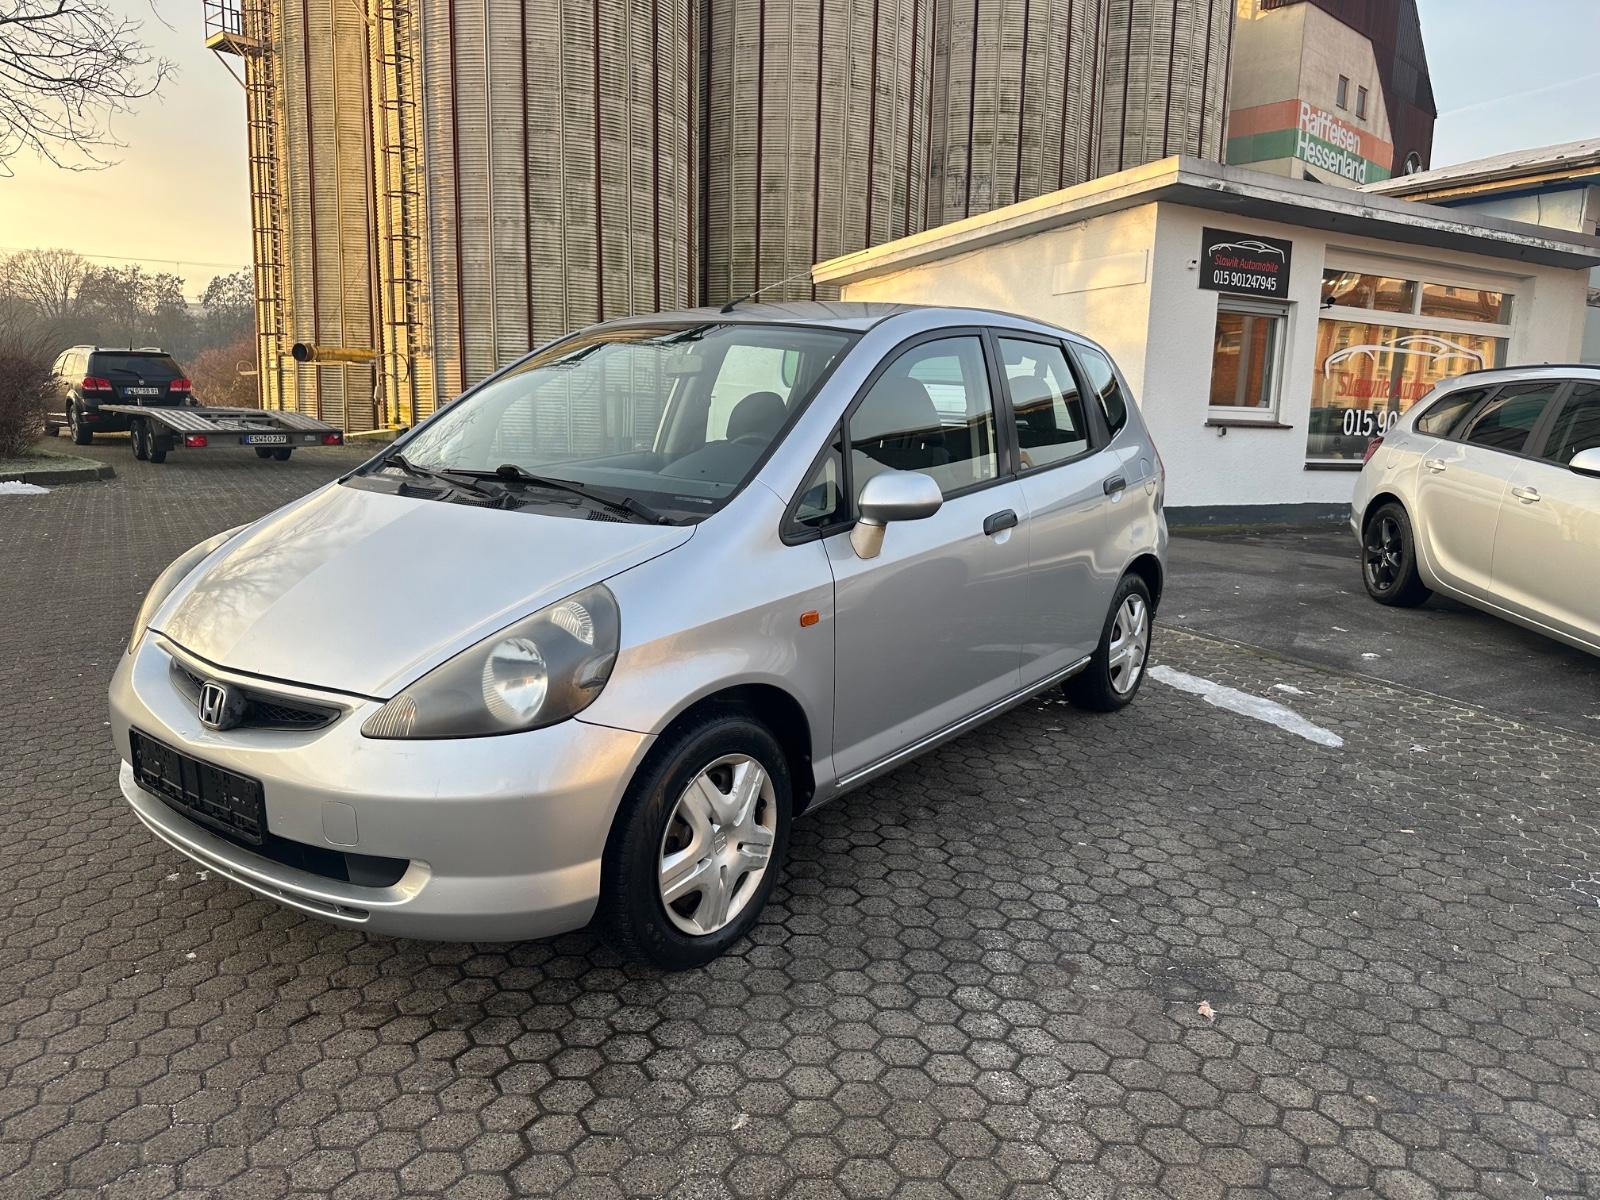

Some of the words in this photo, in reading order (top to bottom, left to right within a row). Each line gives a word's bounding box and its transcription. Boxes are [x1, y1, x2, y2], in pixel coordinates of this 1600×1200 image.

[1299, 101, 1361, 155] Raiffeisen
[1296, 130, 1367, 184] Hessenland
[1240, 258, 1279, 273] Automobile
[1343, 408, 1373, 437] 015
